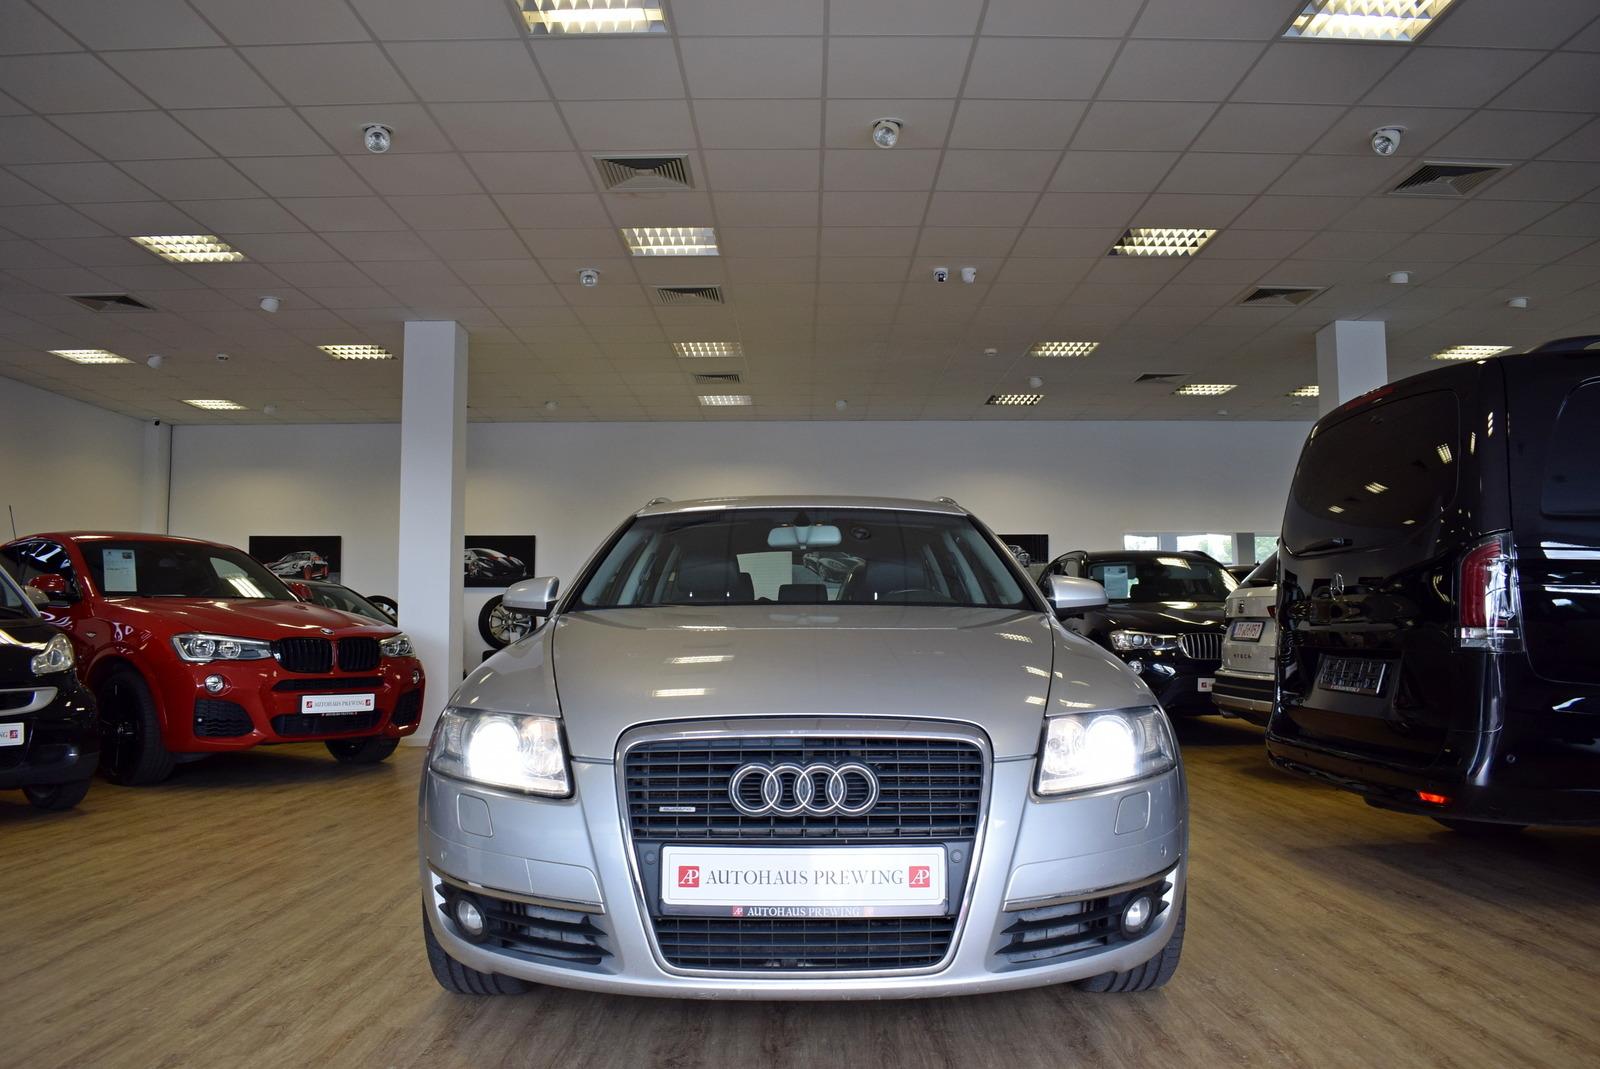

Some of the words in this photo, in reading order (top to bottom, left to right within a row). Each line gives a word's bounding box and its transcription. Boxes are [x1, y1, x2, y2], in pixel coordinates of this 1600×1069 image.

[706, 869, 808, 885] AUTOHAUS
[814, 869, 904, 885] PREWING
[747, 907, 806, 917] AUTOHAUS
[808, 907, 860, 917] PREWING
